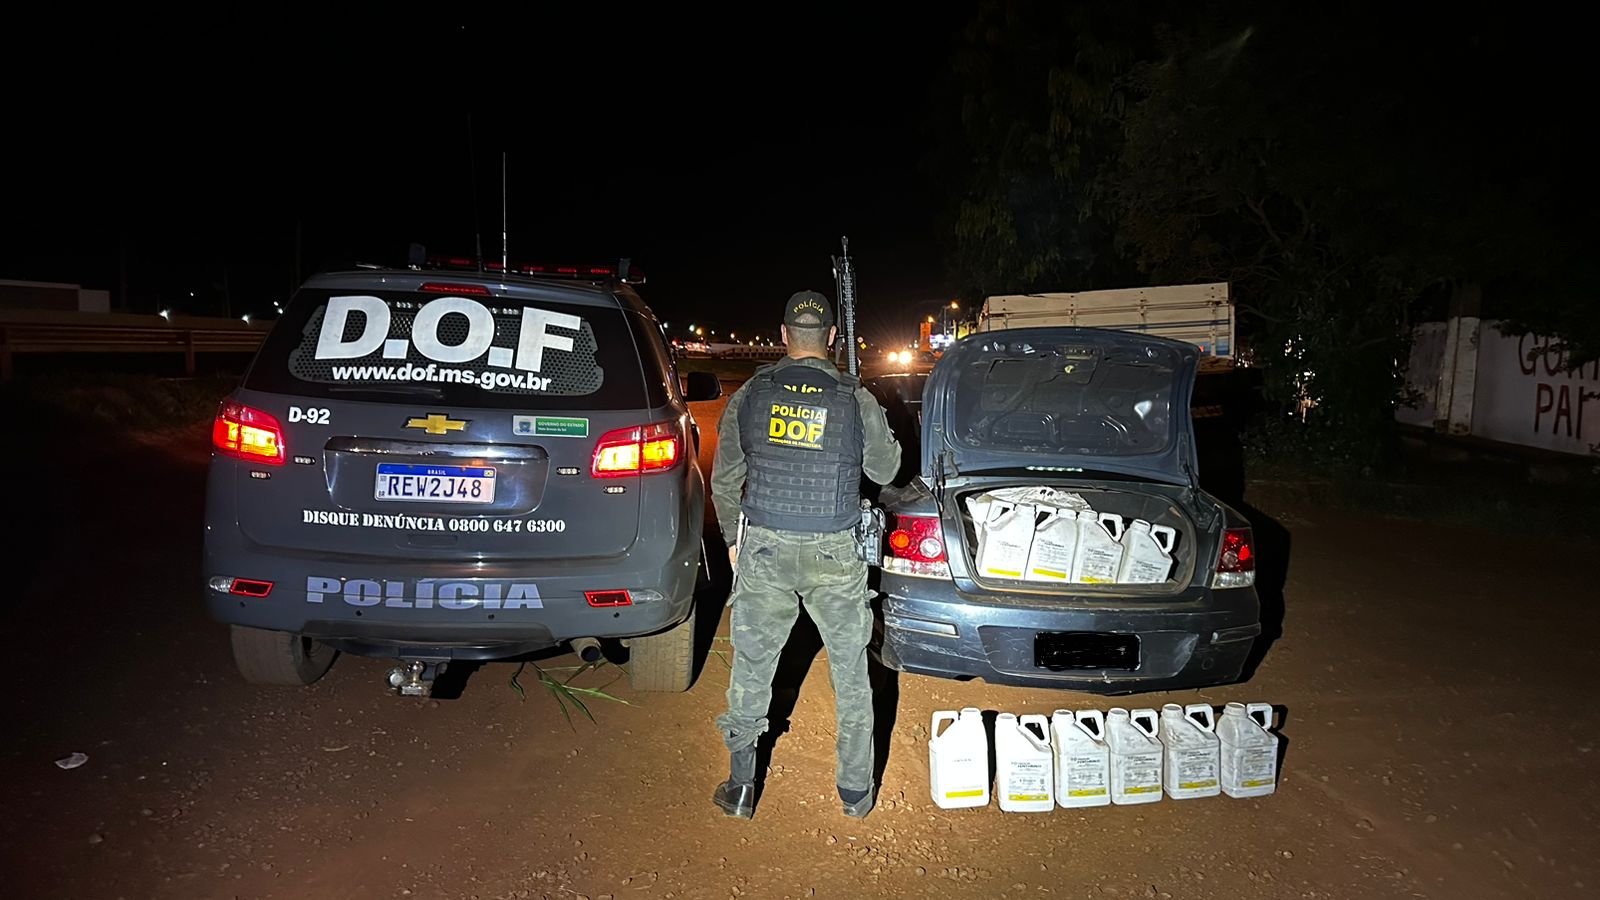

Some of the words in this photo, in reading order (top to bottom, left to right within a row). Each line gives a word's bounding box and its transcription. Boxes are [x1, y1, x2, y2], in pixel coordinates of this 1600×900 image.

[793, 298, 824, 314] POLÍCIA
[315, 295, 581, 373] D.O.F
[332, 363, 552, 391] www.dof.ms.gov.br
[288, 406, 331, 425] D-92
[771, 404, 823, 420] POLÍCIA
[769, 417, 824, 443] DOF
[388, 476, 482, 498] REW2J48
[303, 509, 360, 526] DISQUE
[362, 513, 446, 531] DENÚNCIA
[449, 518, 490, 533] 0800
[493, 519, 521, 533] 647
[526, 519, 566, 533] 6300
[306, 576, 544, 610] POLÍCIA
